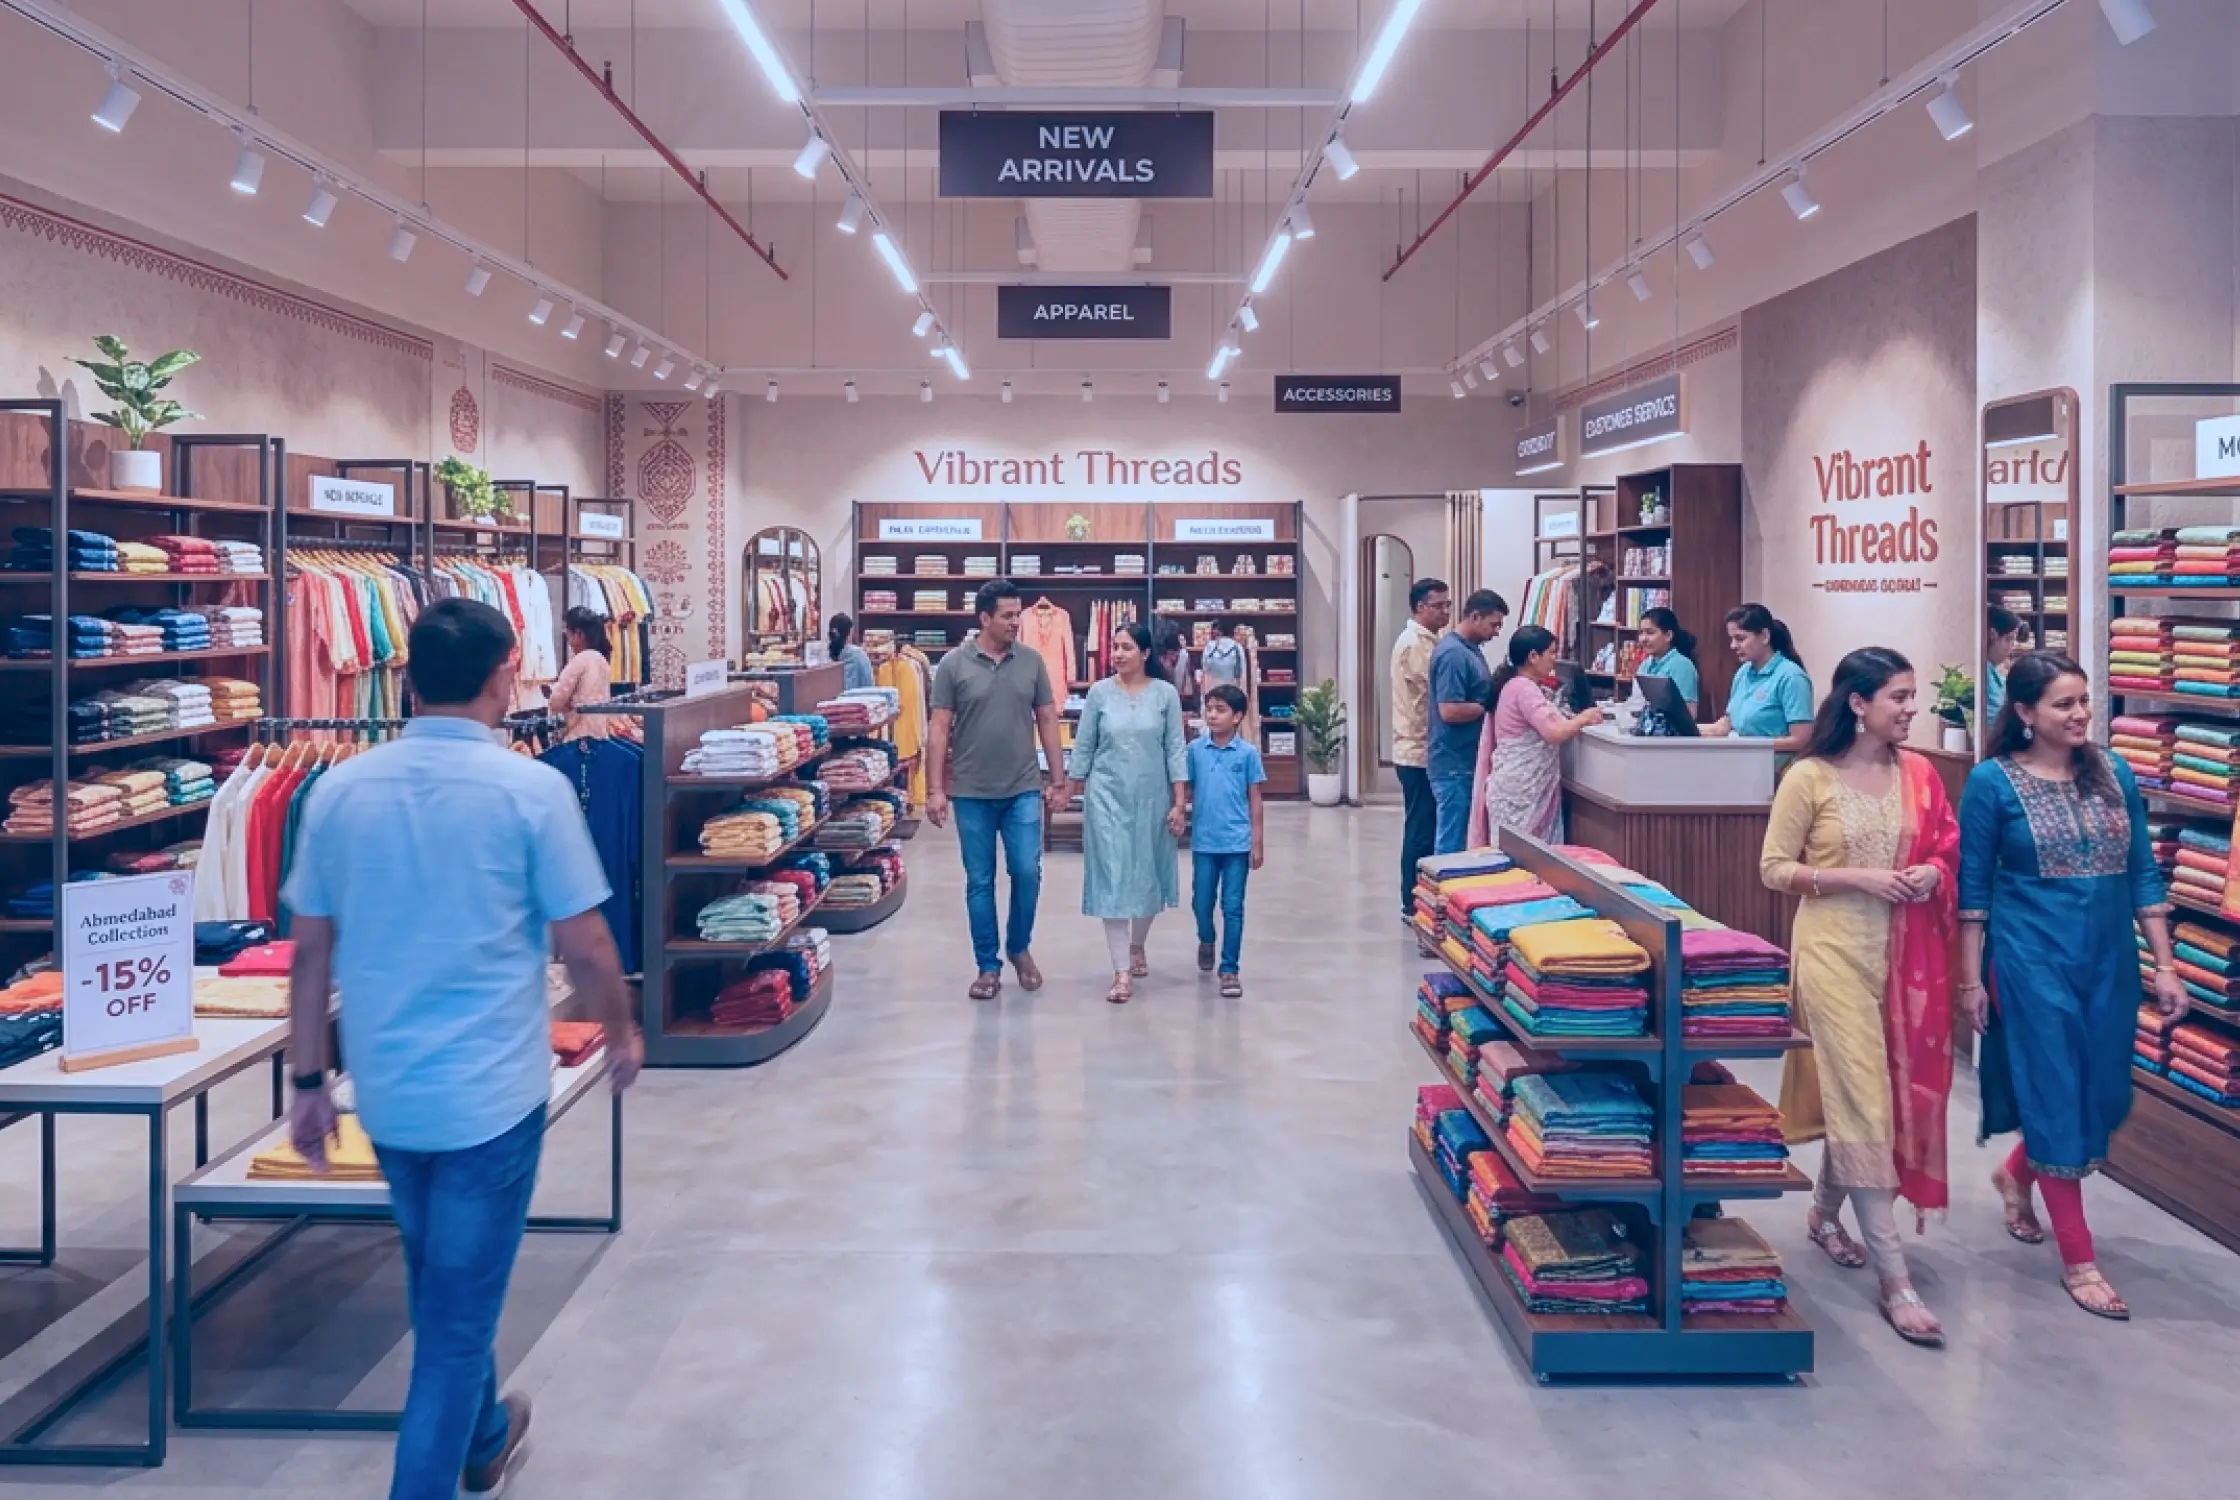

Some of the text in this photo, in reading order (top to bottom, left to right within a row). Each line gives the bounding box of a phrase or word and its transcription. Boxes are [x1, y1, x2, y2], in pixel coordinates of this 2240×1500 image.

[1039, 126, 1115, 149] NEW
[998, 158, 1155, 182] ARRIVALS
[1033, 304, 1135, 320] APPAREL
[1283, 387, 1392, 402] ACCESSORIES
[2217, 434, 2240, 460] M
[913, 450, 1242, 484] Vibrant Threads
[1812, 439, 1933, 503] Vibrant
[1810, 505, 1939, 565] Threads
[88, 924, 169, 946] Collection
[81, 954, 171, 992] -15%
[106, 993, 156, 1017] OFF
